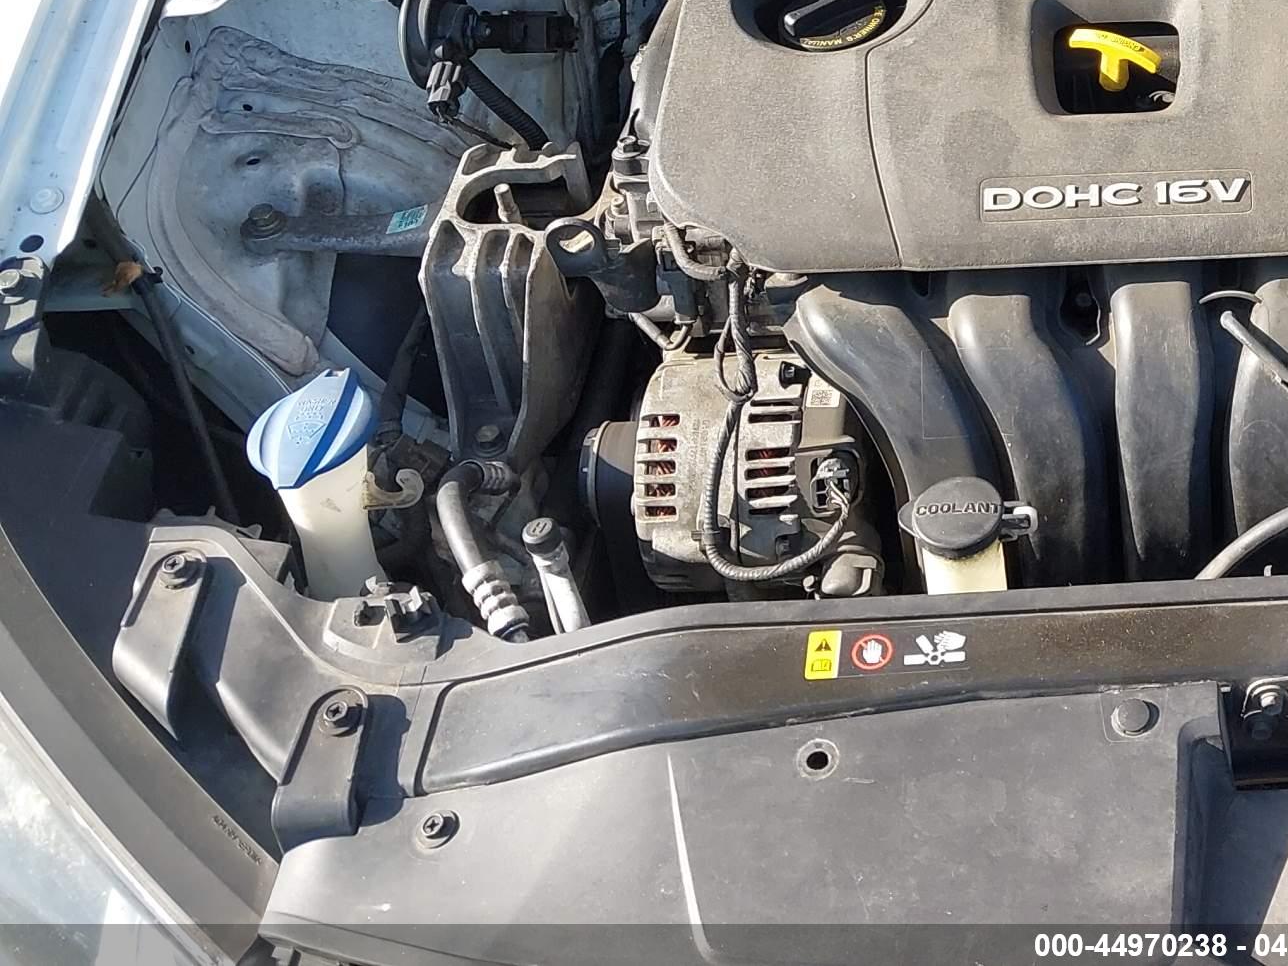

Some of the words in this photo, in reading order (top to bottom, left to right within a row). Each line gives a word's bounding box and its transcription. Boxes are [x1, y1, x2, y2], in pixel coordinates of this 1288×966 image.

[801, 37, 843, 48] MANUAL
[983, 182, 1143, 212] DOHC
[1156, 178, 1250, 204] 16V
[915, 502, 1002, 516] COOLANT
